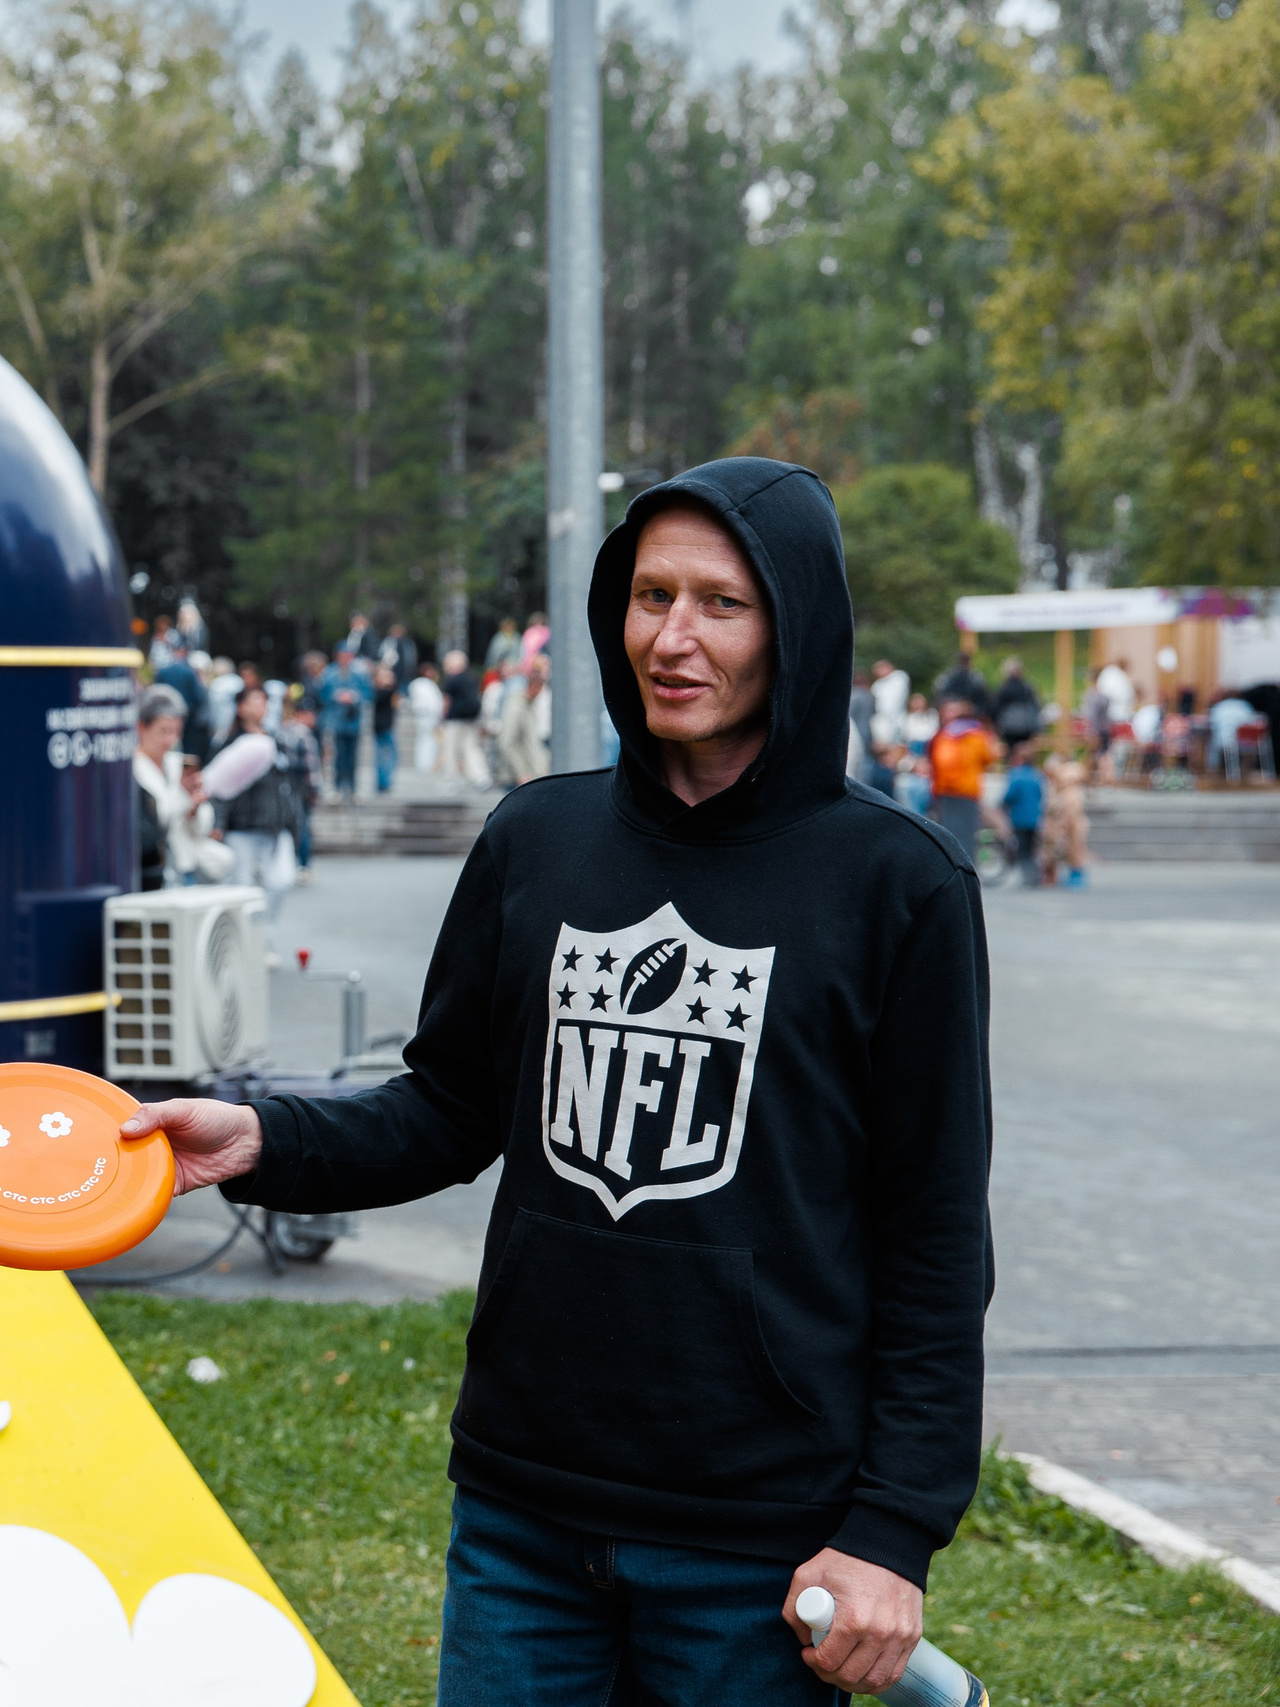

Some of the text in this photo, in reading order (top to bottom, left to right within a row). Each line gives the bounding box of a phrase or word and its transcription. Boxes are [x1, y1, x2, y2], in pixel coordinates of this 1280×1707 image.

[550, 1026, 720, 1180] NFL
[2, 1190, 28, 1203] СТС
[30, 1196, 56, 1205] СТС
[57, 1189, 82, 1203] СТС
[80, 1175, 100, 1192] СТС
[94, 1157, 107, 1176] СТС
